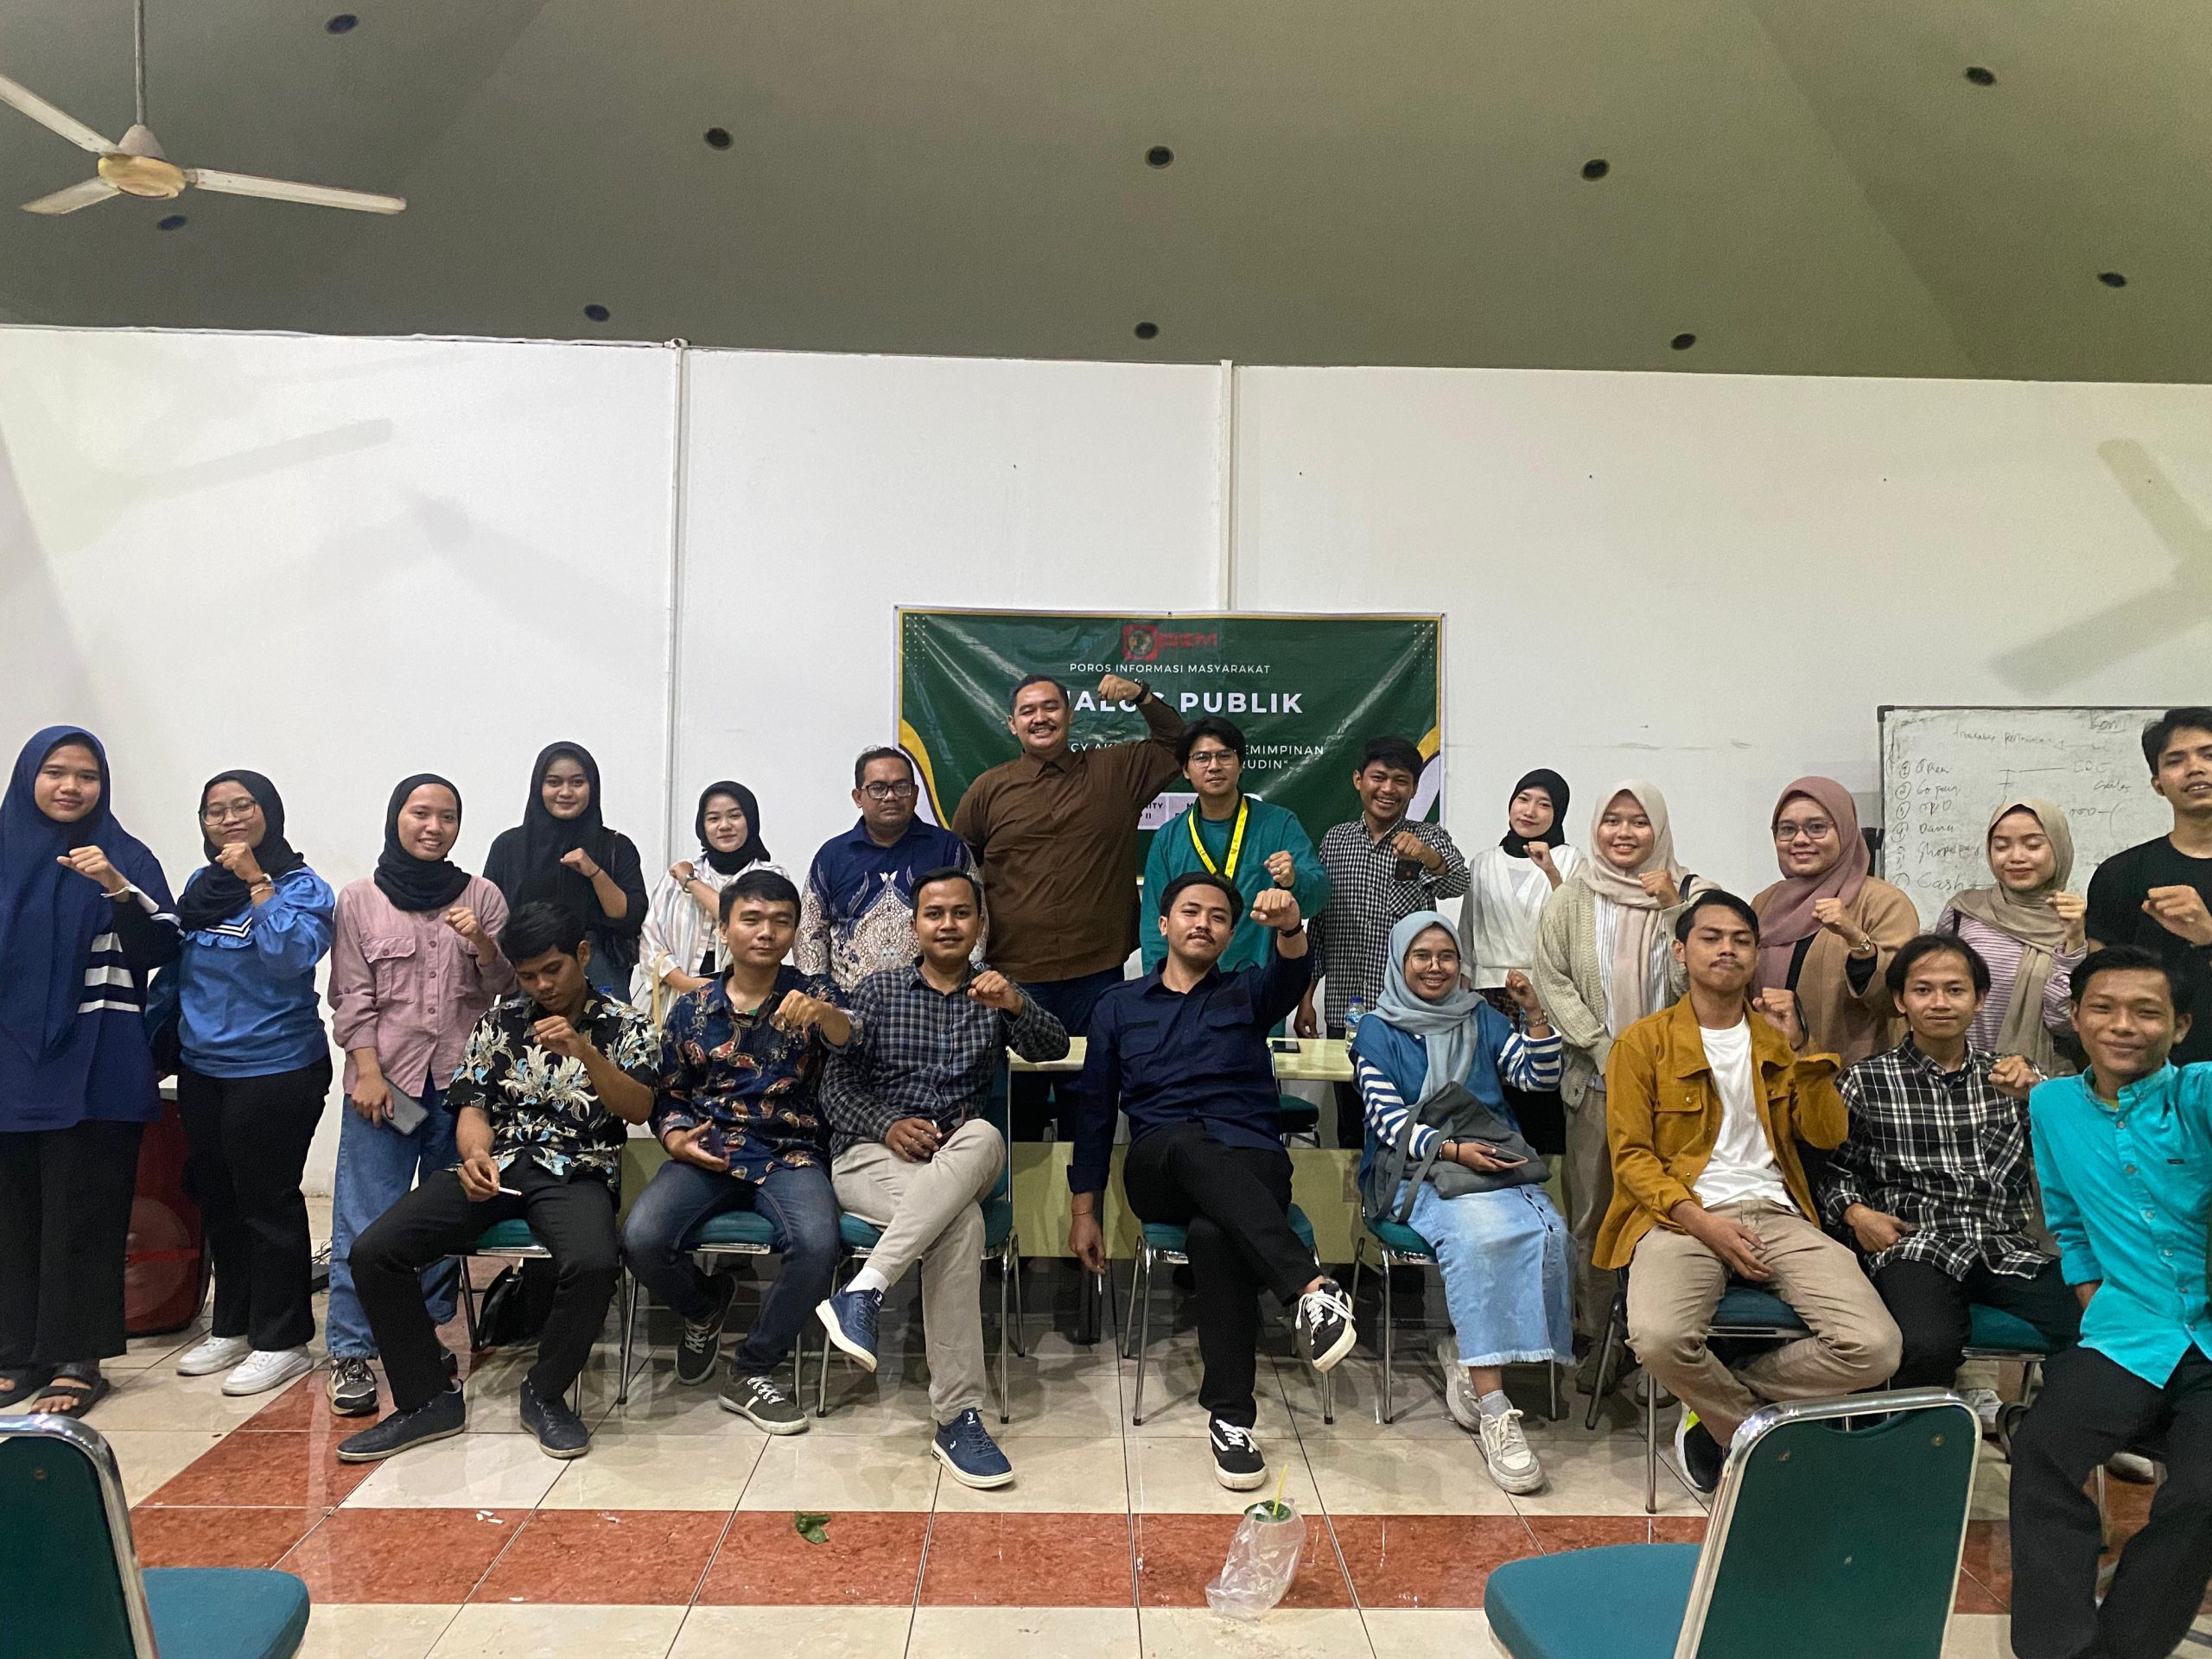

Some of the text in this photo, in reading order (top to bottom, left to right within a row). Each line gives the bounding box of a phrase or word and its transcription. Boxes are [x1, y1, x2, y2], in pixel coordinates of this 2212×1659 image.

[1070, 664, 1270, 675] POROS INFORMASI MASYARAKAT
[1180, 692, 1303, 714] PUBLIK
